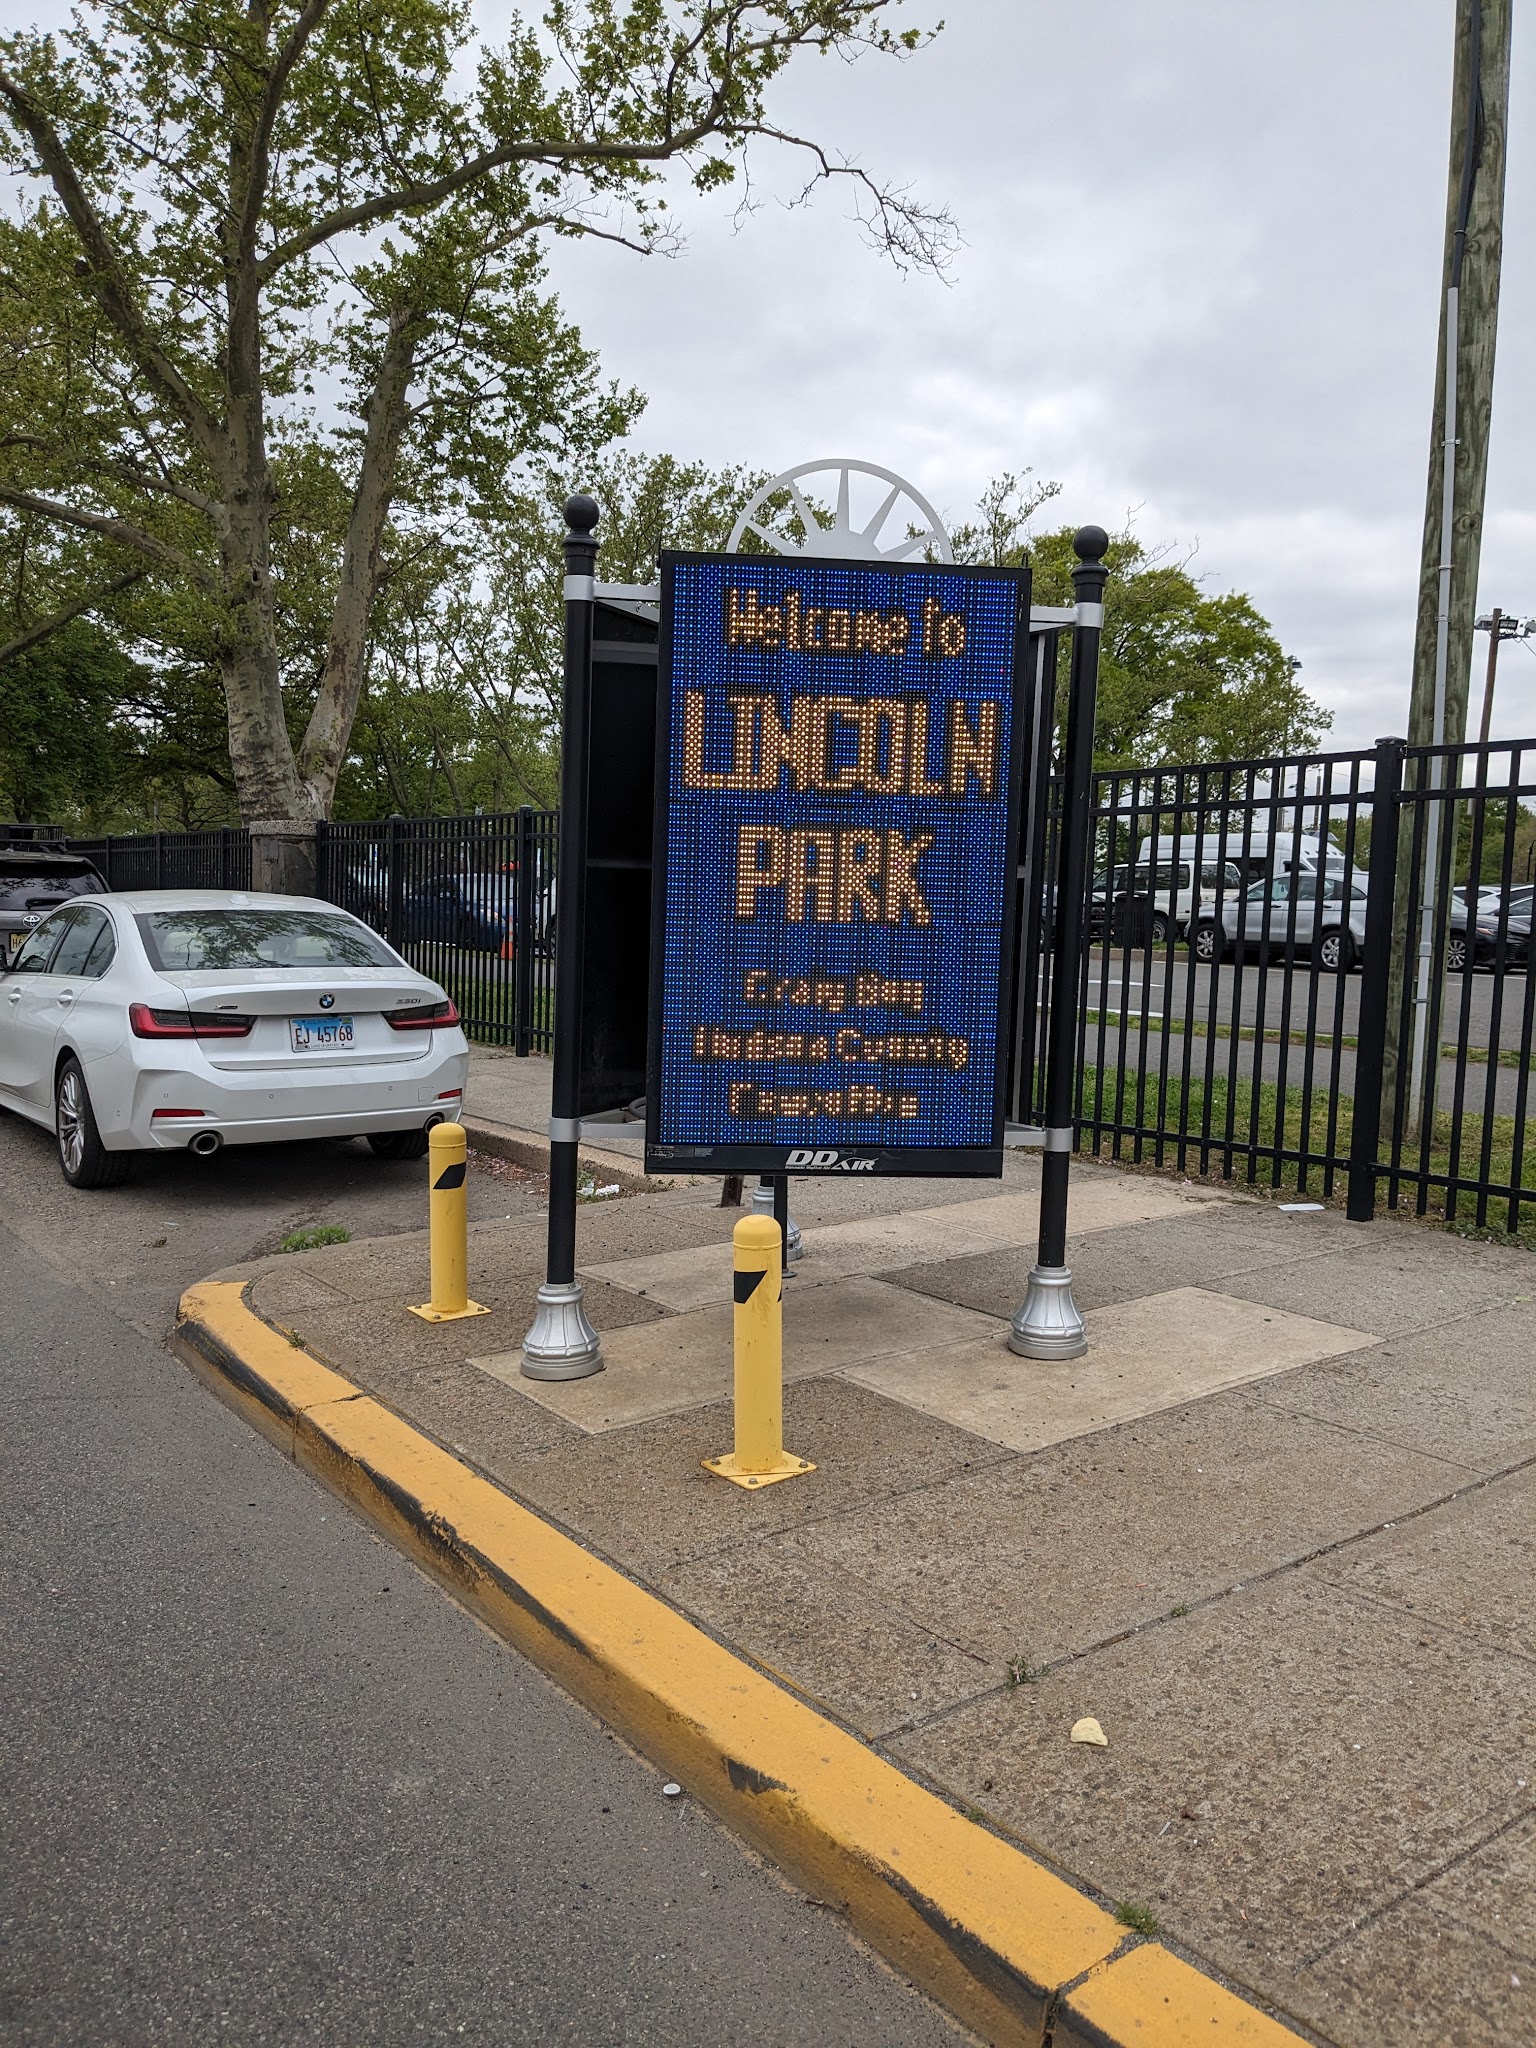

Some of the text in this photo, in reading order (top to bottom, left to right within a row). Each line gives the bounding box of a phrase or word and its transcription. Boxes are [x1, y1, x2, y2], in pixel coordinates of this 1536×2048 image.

[729, 588, 966, 656] Welcome to
[682, 691, 997, 797] LINCOLN
[736, 825, 933, 926] PARK
[295, 1025, 353, 1045] EJ 45768
